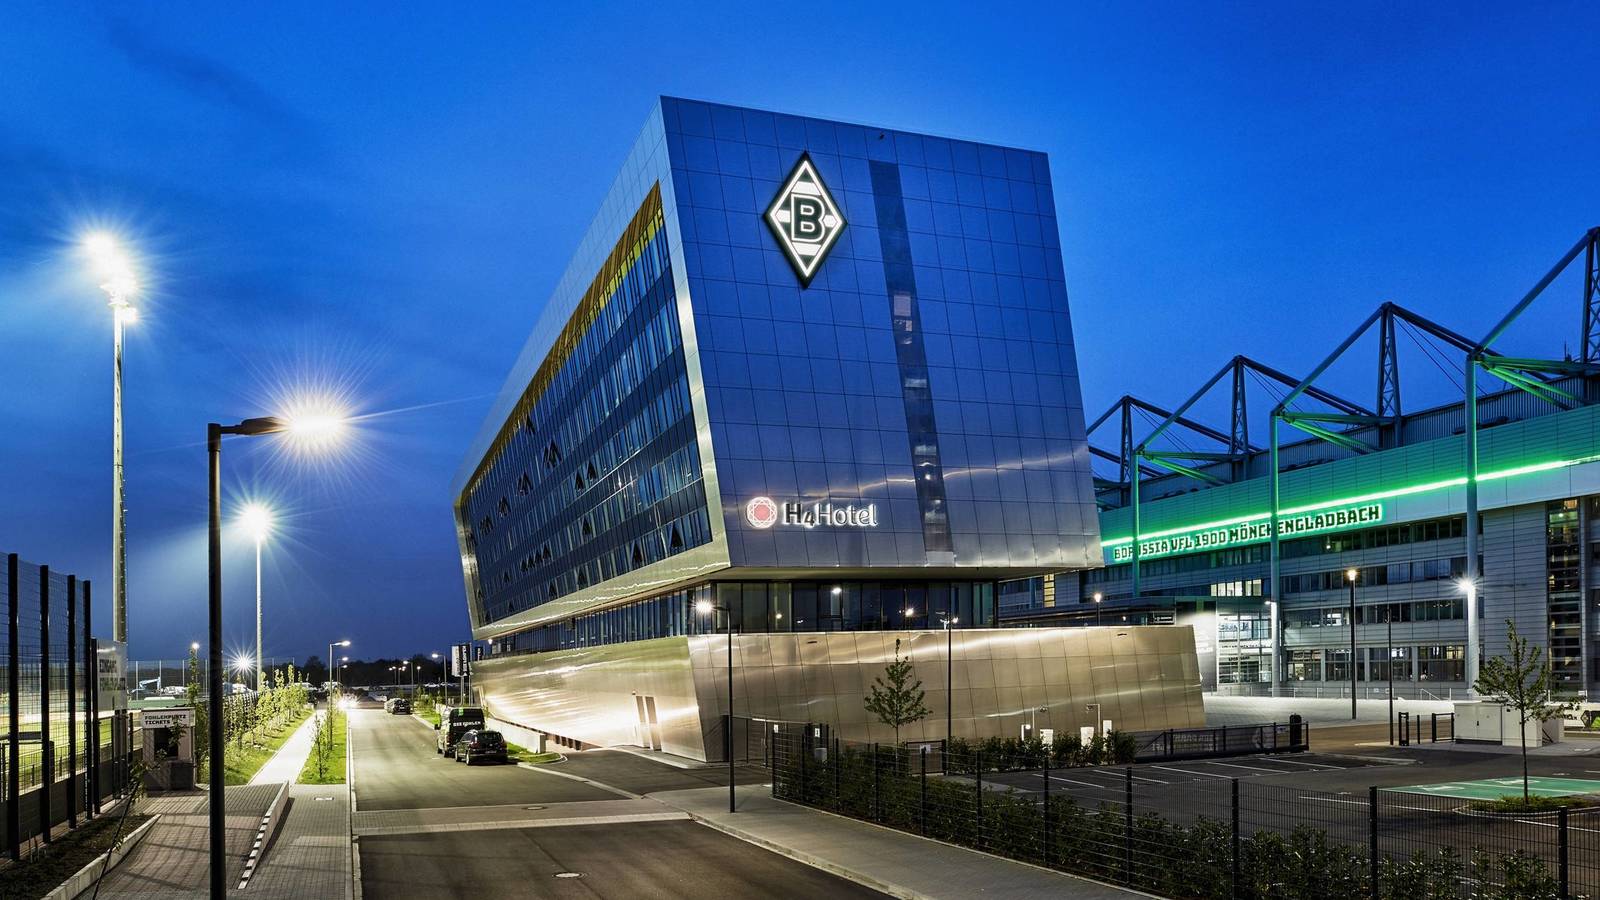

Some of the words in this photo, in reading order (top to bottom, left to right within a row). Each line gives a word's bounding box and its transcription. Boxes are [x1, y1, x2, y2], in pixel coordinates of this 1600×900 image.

[791, 193, 826, 242] B
[1171, 537, 1192, 552] VFL
[1195, 531, 1226, 547] 1900
